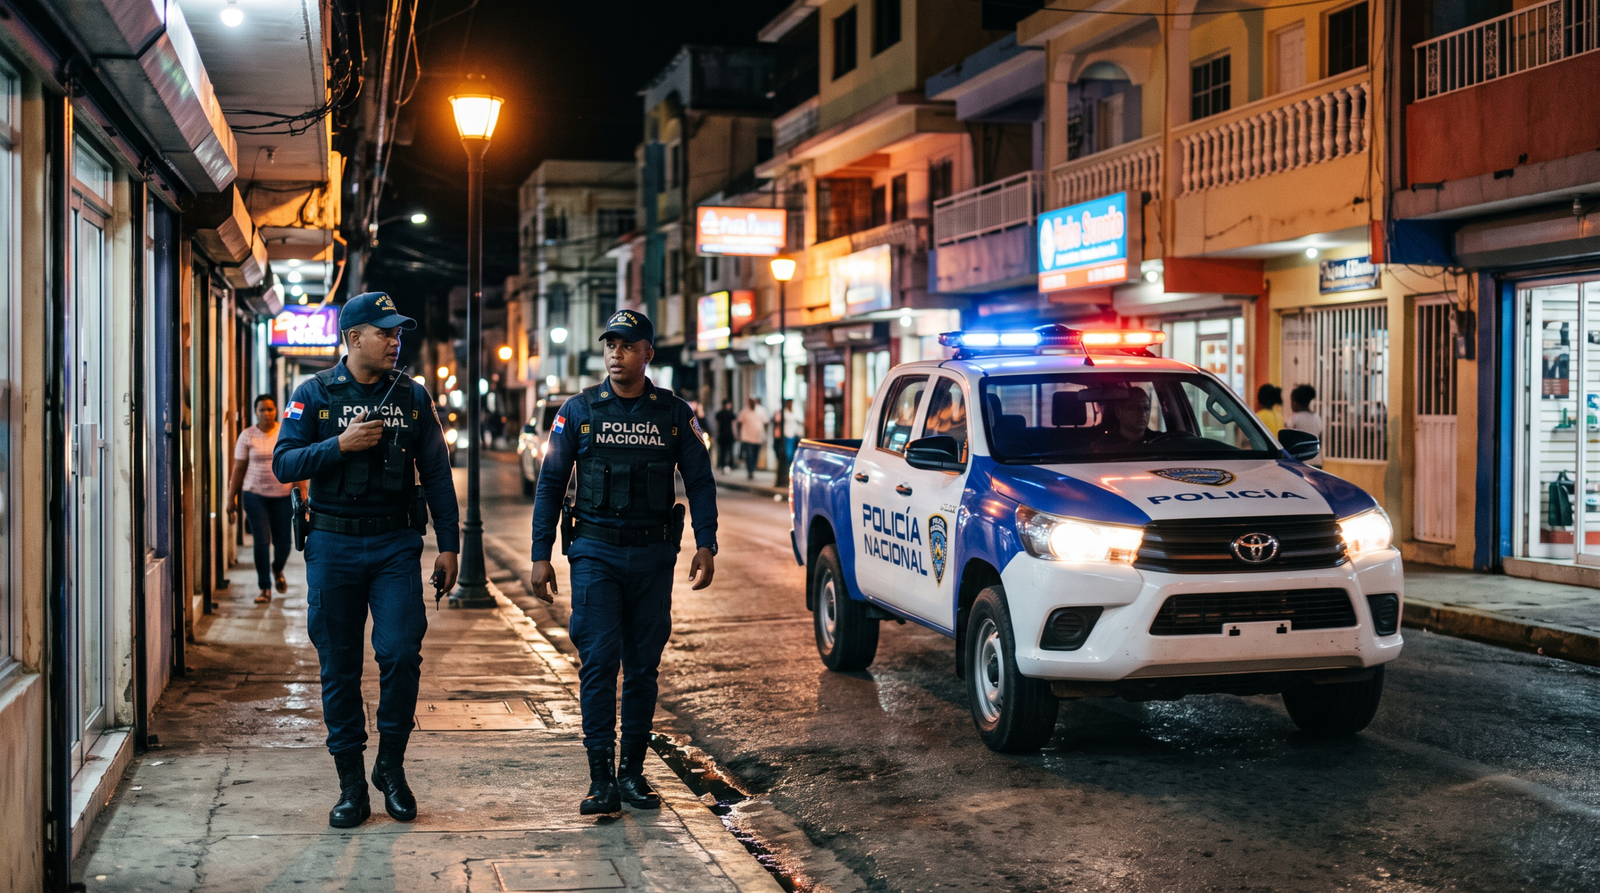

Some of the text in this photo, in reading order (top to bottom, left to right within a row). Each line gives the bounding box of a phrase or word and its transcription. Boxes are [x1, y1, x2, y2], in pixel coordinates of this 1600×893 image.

[338, 417, 408, 428] NNAL
[602, 421, 660, 435] POLICÍA
[596, 433, 665, 446] NACIONAL
[1147, 488, 1309, 505] POLICÍA
[863, 503, 922, 546] POLICÍA
[864, 533, 928, 577] NACIONAL
